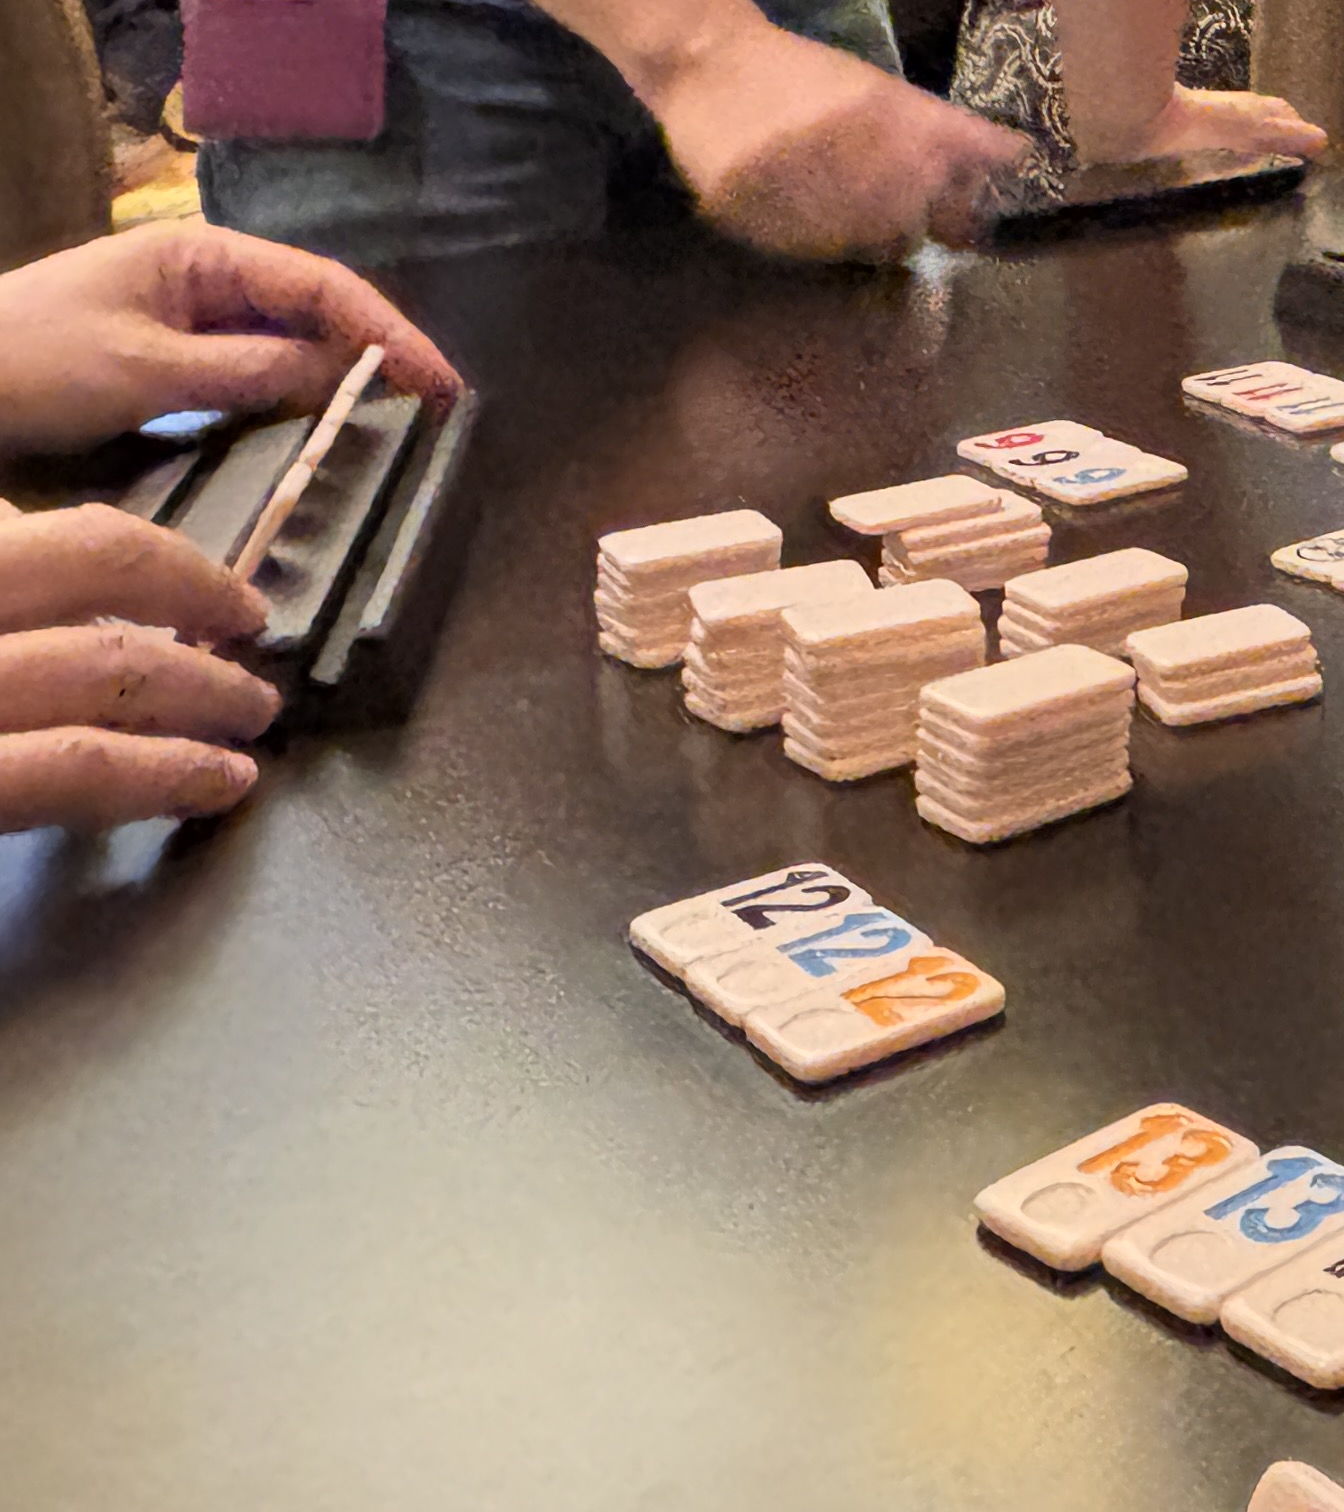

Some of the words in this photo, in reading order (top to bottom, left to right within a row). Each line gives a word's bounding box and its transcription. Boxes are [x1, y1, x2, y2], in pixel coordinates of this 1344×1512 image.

[719, 870, 852, 930] 12
[776, 911, 913, 978] 12
[839, 955, 983, 1027] 12
[1076, 1112, 1235, 1199] 13
